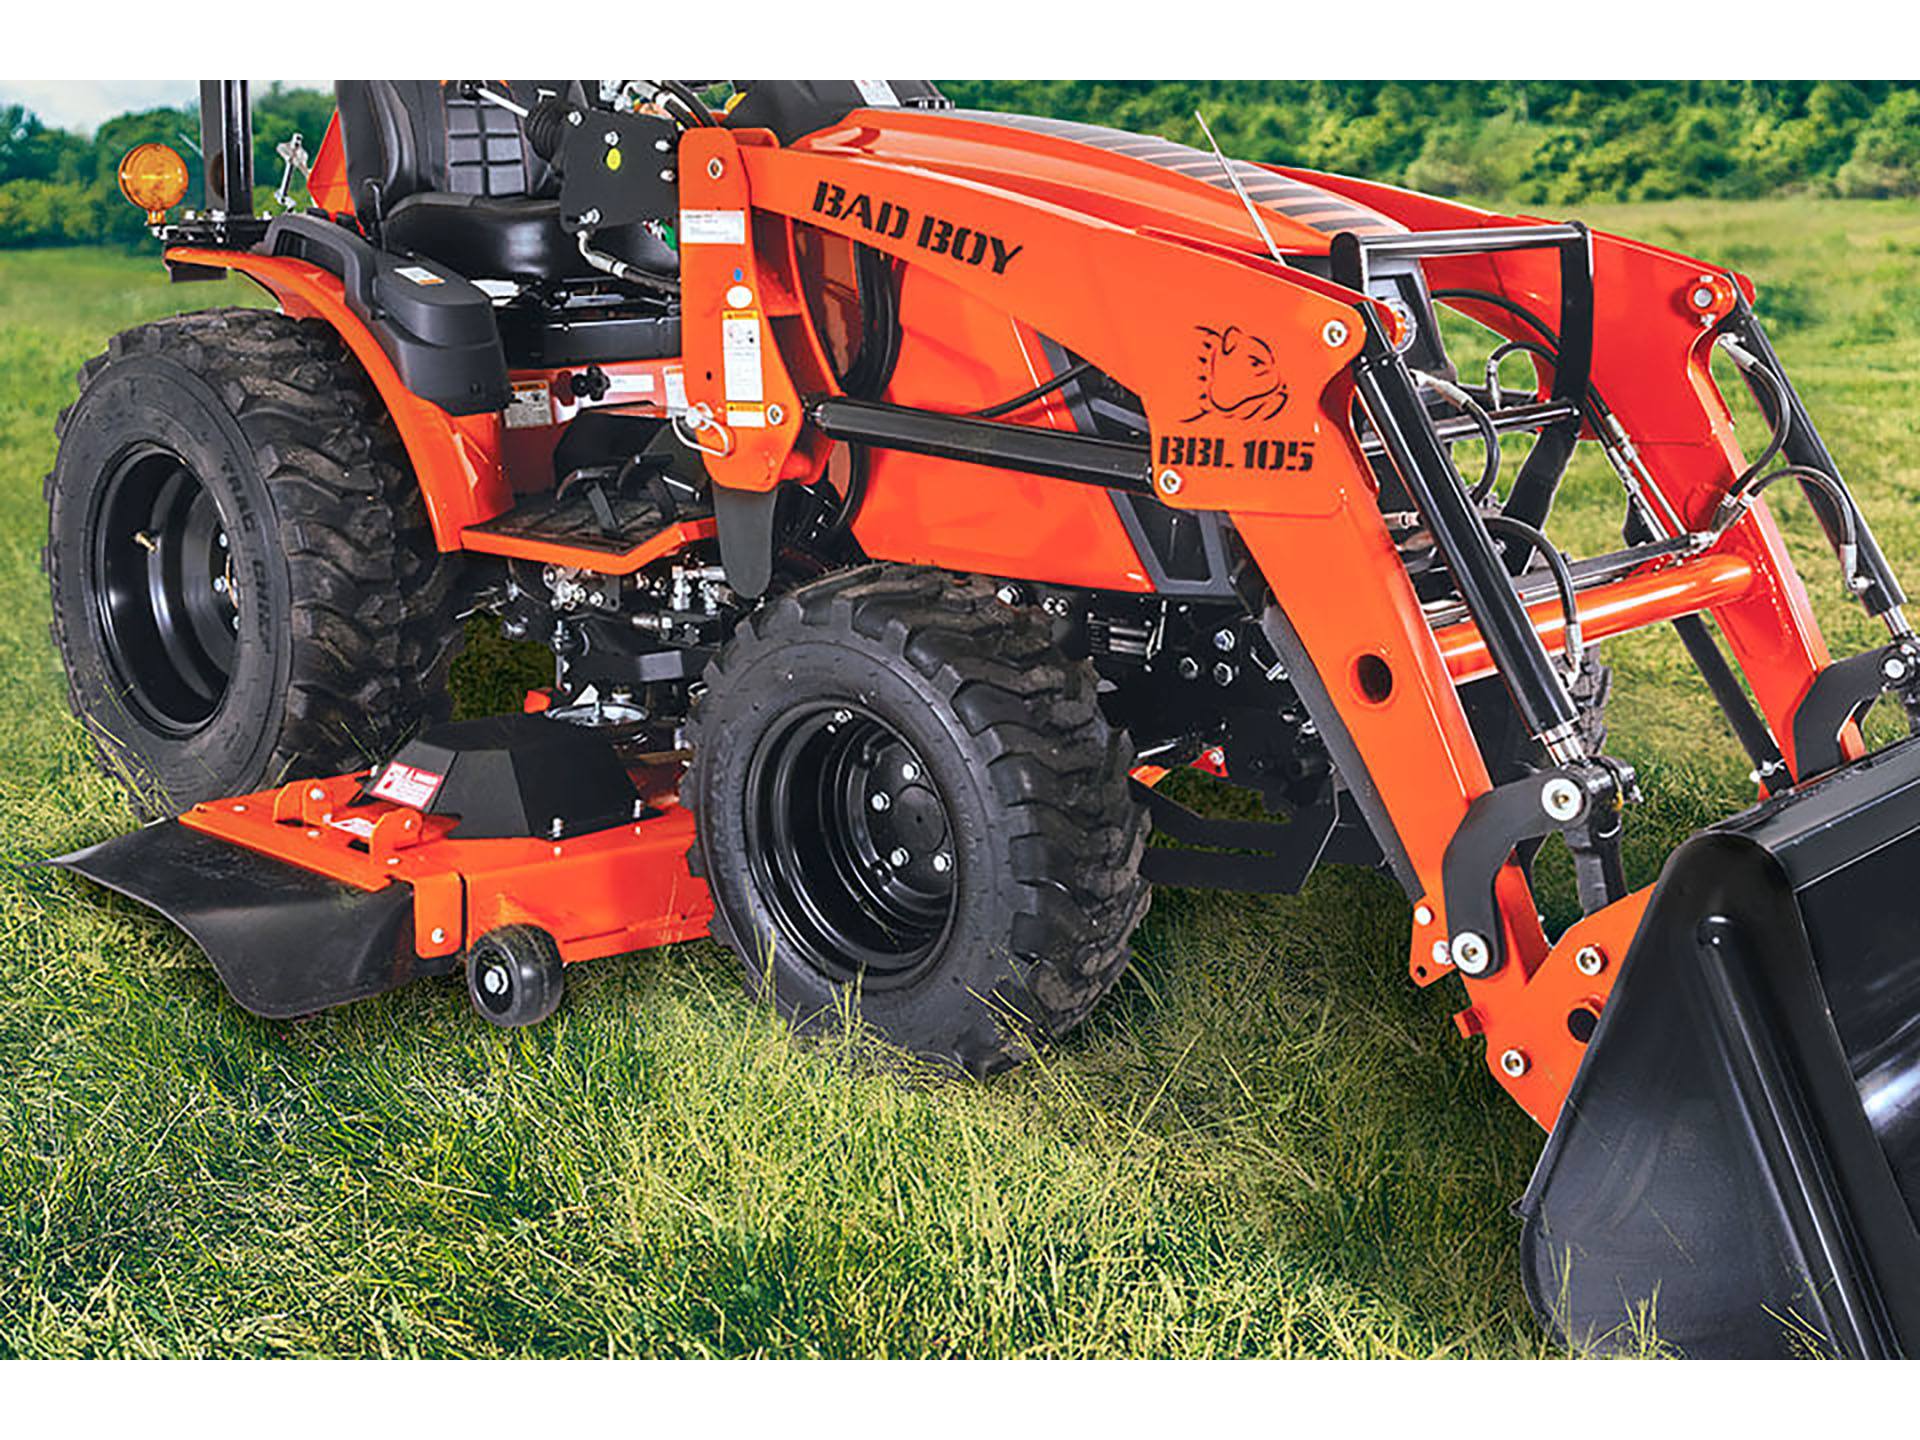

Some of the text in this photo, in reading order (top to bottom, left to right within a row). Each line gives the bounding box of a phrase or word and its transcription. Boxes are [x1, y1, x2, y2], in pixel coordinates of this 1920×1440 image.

[812, 180, 909, 239] BAD
[917, 215, 1023, 275] BOY
[1159, 436, 1315, 471] BBL 105
